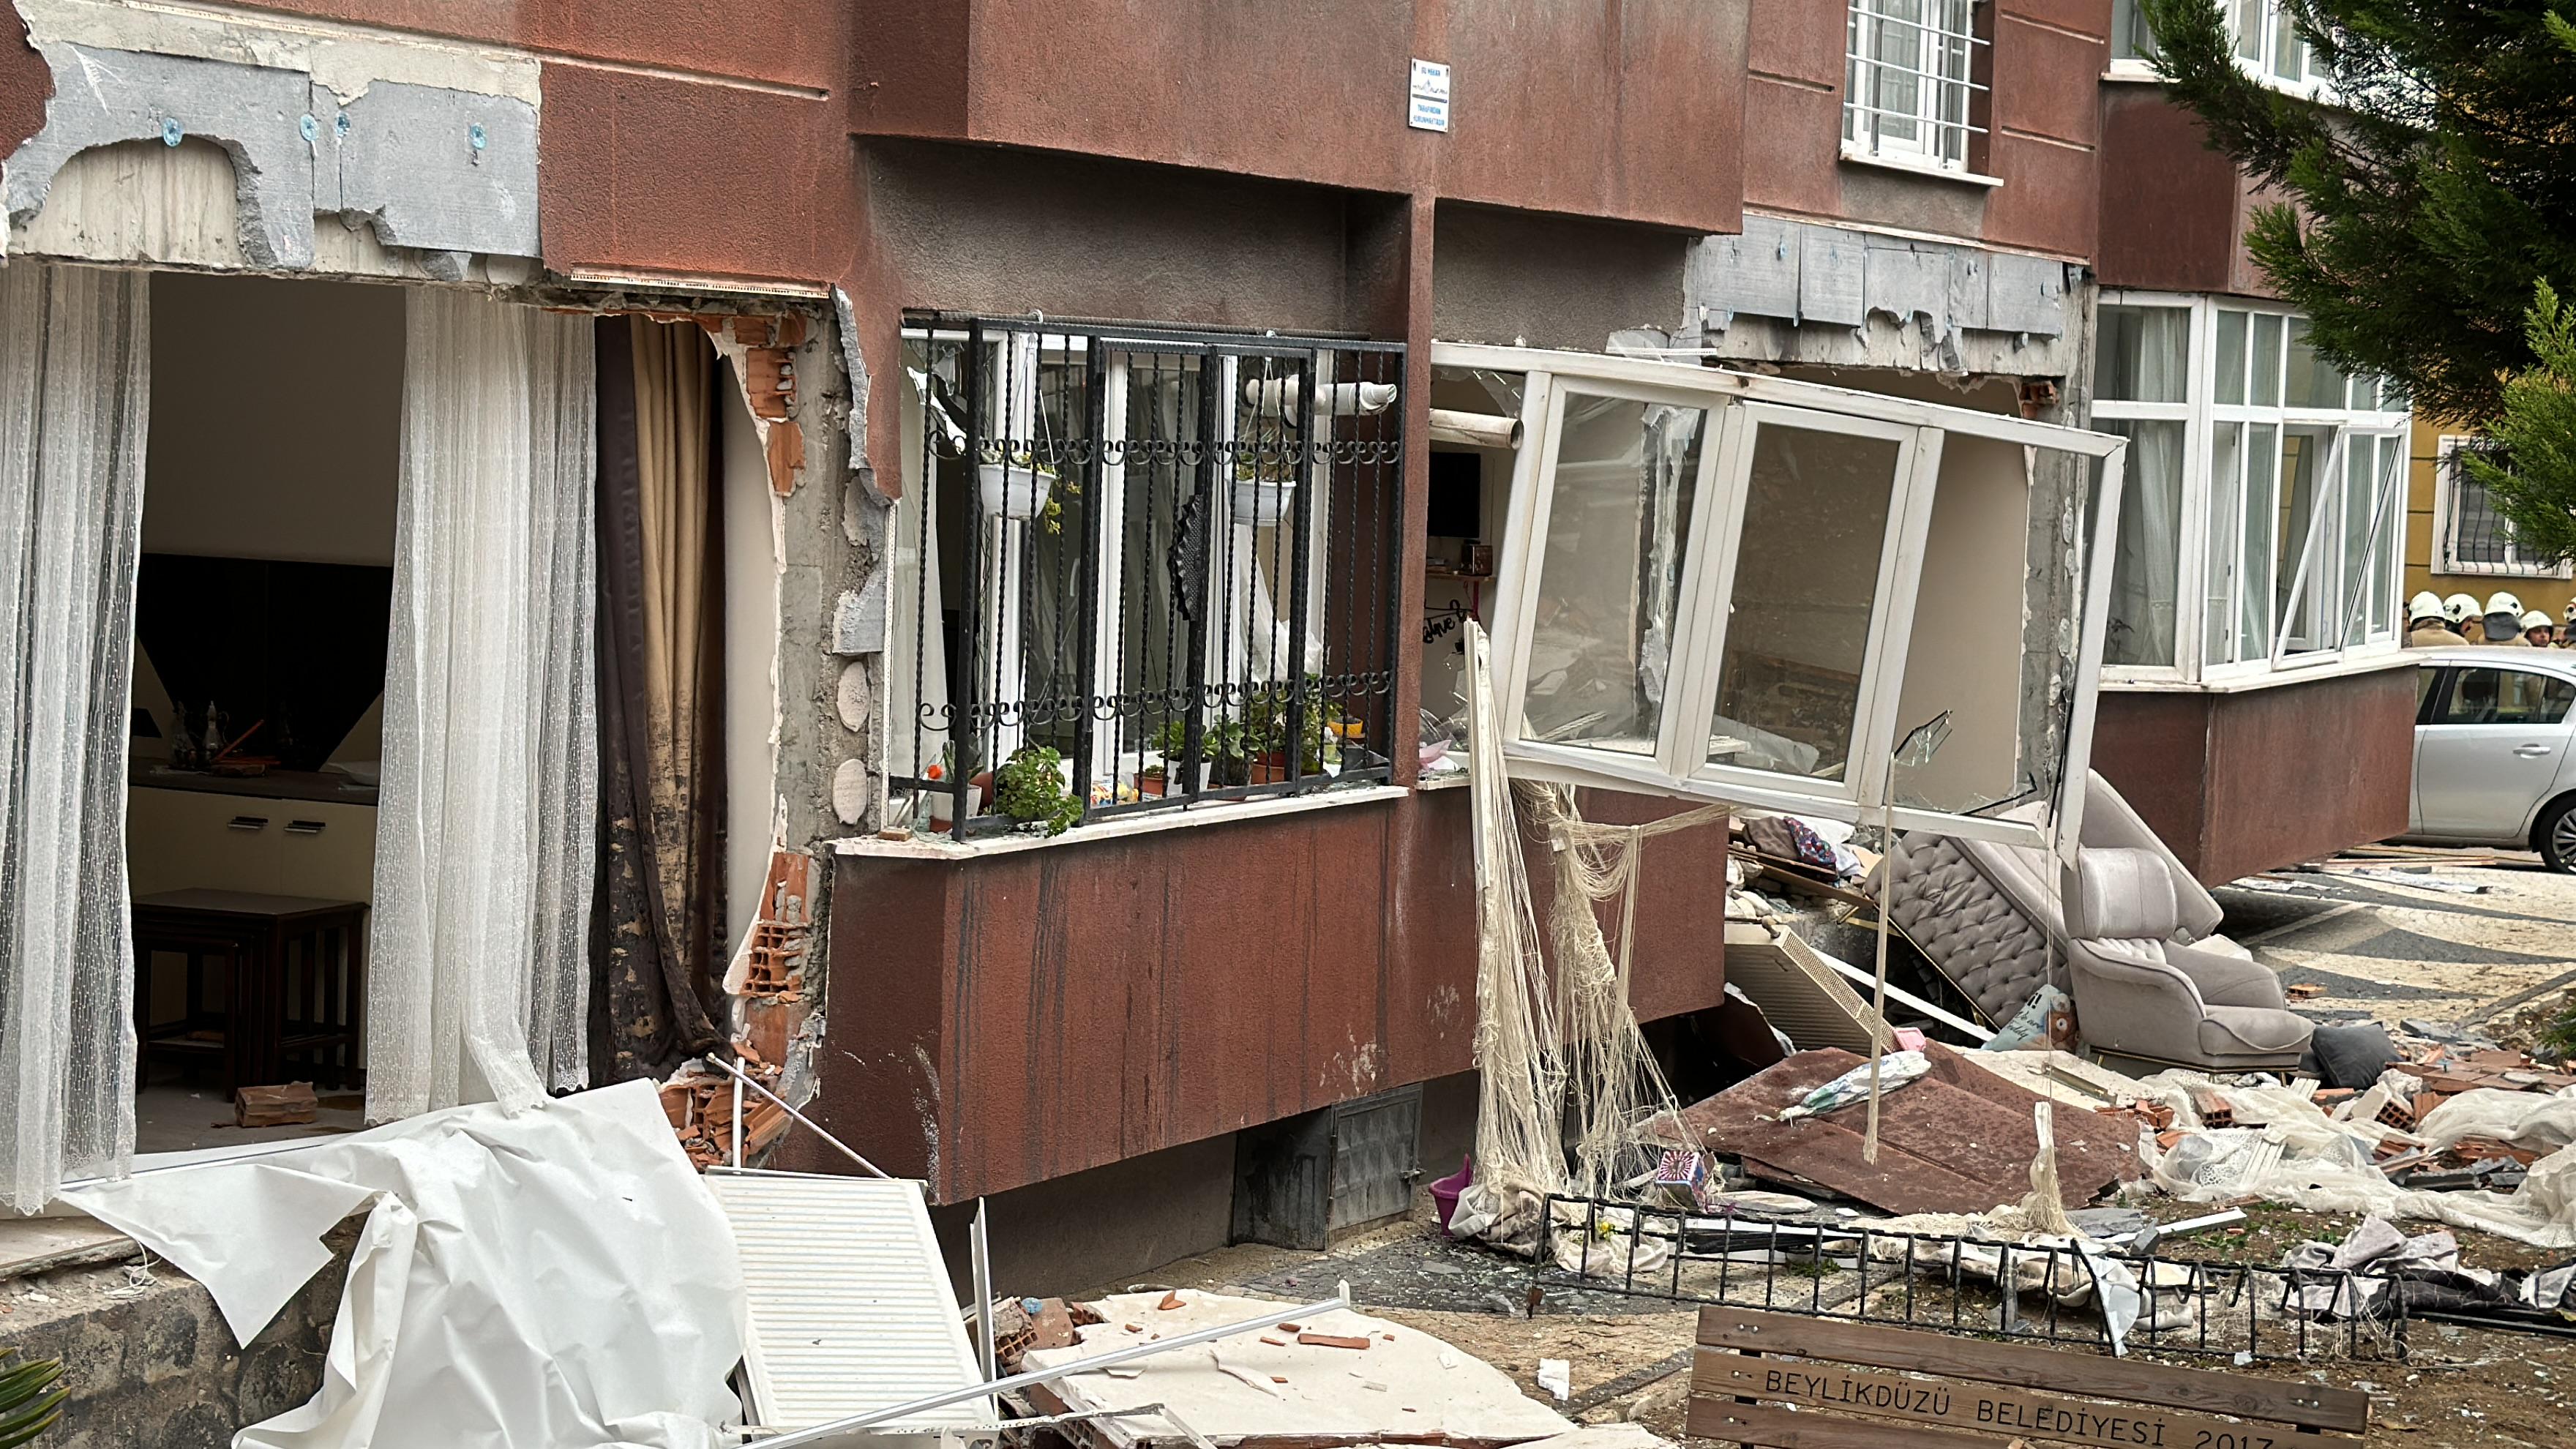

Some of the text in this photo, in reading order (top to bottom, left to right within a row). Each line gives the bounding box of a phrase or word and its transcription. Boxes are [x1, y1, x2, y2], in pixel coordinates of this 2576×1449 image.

[2027, 992, 2043, 1009] i!
[1765, 1370, 1950, 1415] BEYLİKDÜZÜ
[1977, 1399, 2165, 1446] BELEDİYESİ
